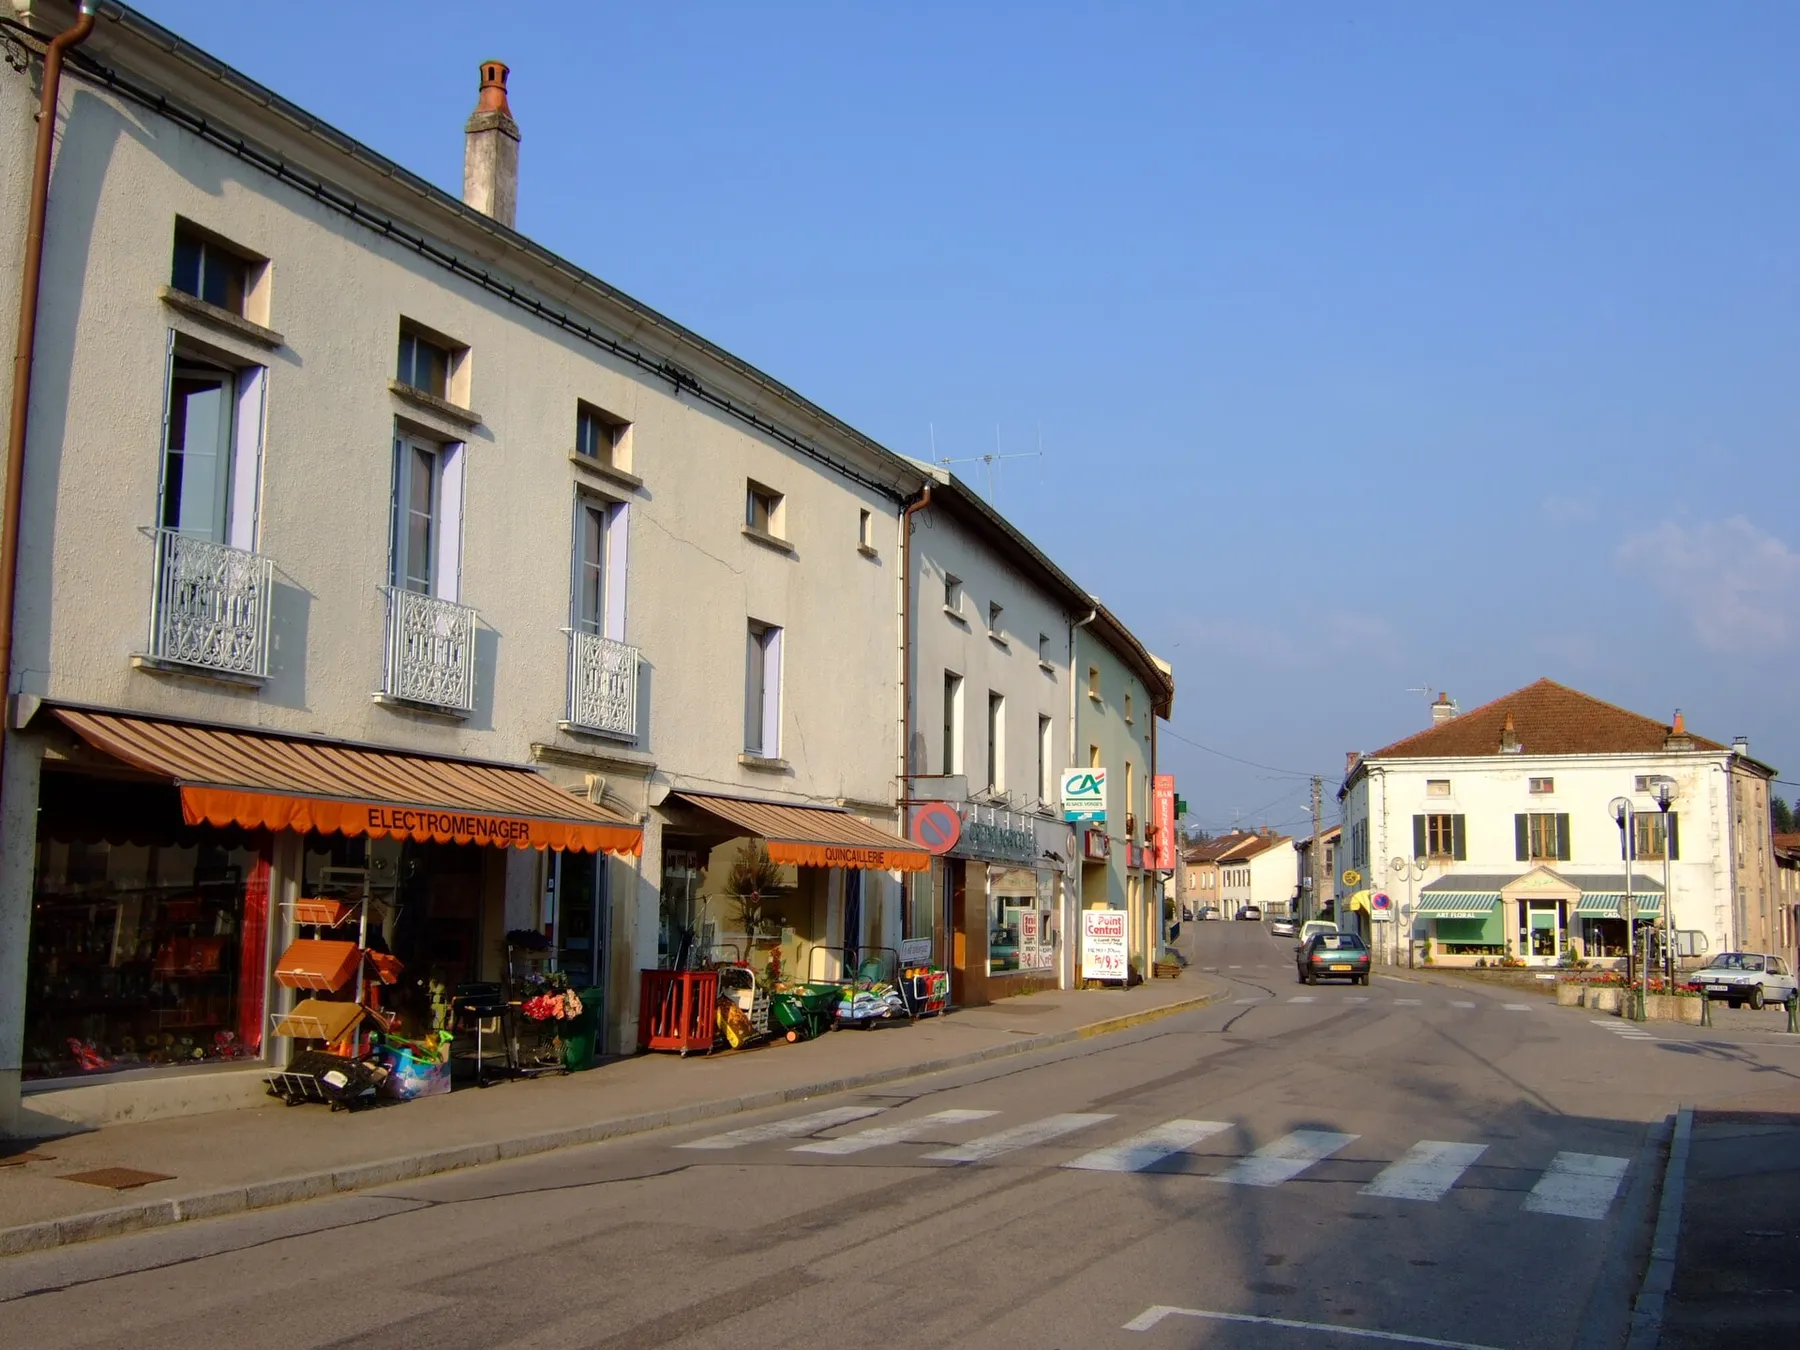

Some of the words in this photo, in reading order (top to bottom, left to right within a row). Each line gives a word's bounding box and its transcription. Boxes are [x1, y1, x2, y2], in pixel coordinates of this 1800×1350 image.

[1157, 790, 1172, 798] BAR
[368, 810, 530, 840] ELECTROMENAGER
[825, 847, 885, 864] QUINCAILLERIE
[1098, 916, 1121, 926] Point
[1088, 925, 1121, 935] Central
